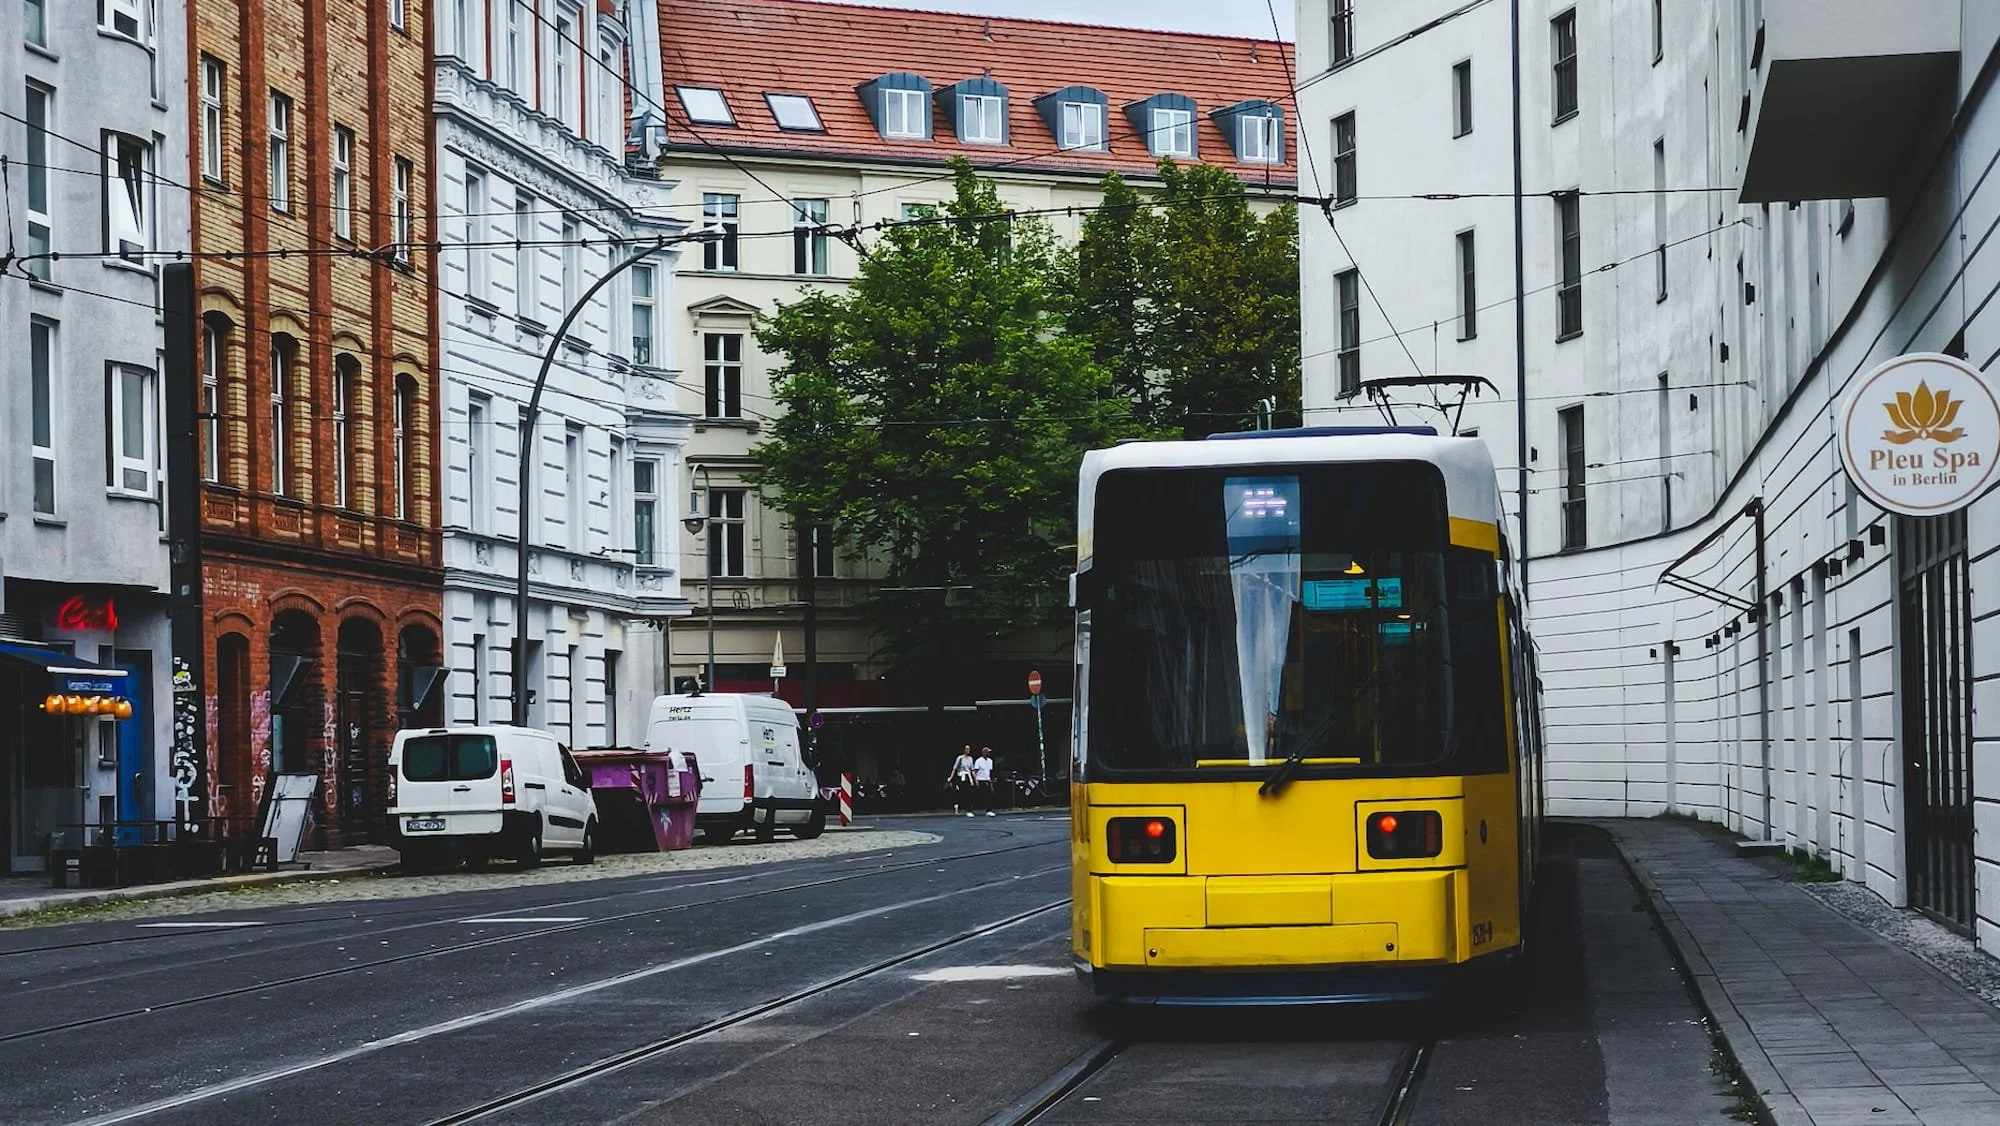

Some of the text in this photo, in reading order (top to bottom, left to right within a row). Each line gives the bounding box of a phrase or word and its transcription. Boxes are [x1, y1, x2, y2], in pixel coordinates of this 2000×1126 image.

[1870, 447, 1981, 473] Pleu Spa
[1893, 472, 1957, 486] in Berlin
